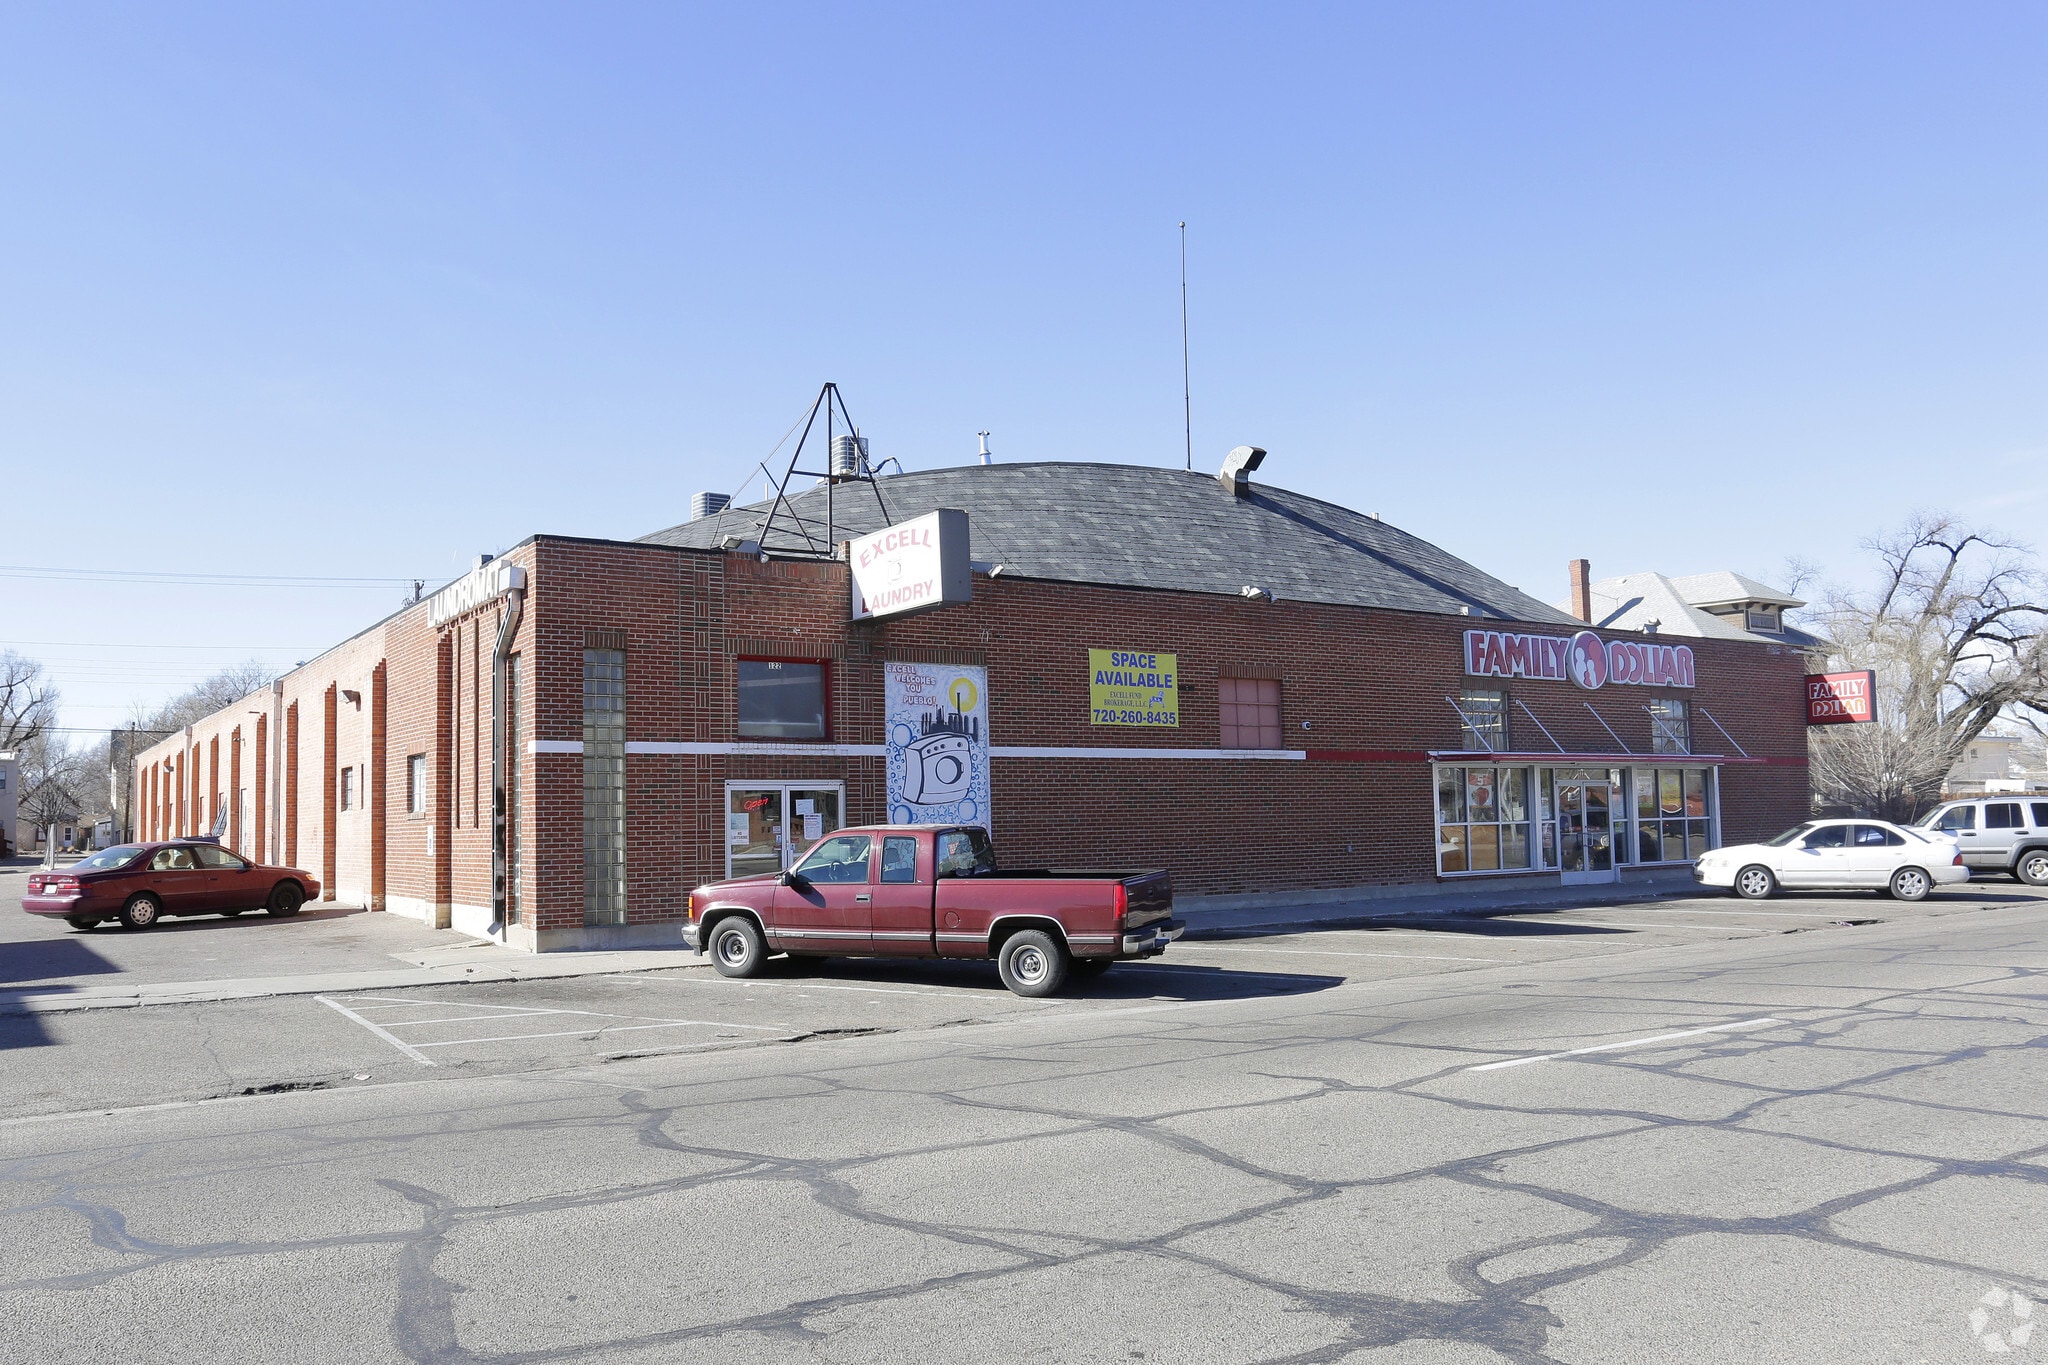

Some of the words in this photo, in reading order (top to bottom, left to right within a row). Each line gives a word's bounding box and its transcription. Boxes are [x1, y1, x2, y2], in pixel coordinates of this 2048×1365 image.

[860, 528, 932, 569] EXCELL
[427, 560, 501, 628] LAUNDROMAT
[1111, 652, 1157, 669] SPACE
[1465, 630, 1571, 681] FAMILY
[1606, 641, 1695, 688] DOLLAR
[885, 664, 916, 674] EXCELL
[895, 674, 936, 685] WELCOMES
[1095, 671, 1173, 688] AVAILABLE
[906, 684, 921, 693] YOU
[1808, 679, 1866, 699] FAMILY
[903, 696, 936, 706] PUEBLO!
[1812, 698, 1866, 717] DOLLAR
[1093, 709, 1176, 725] 720-260-8435
